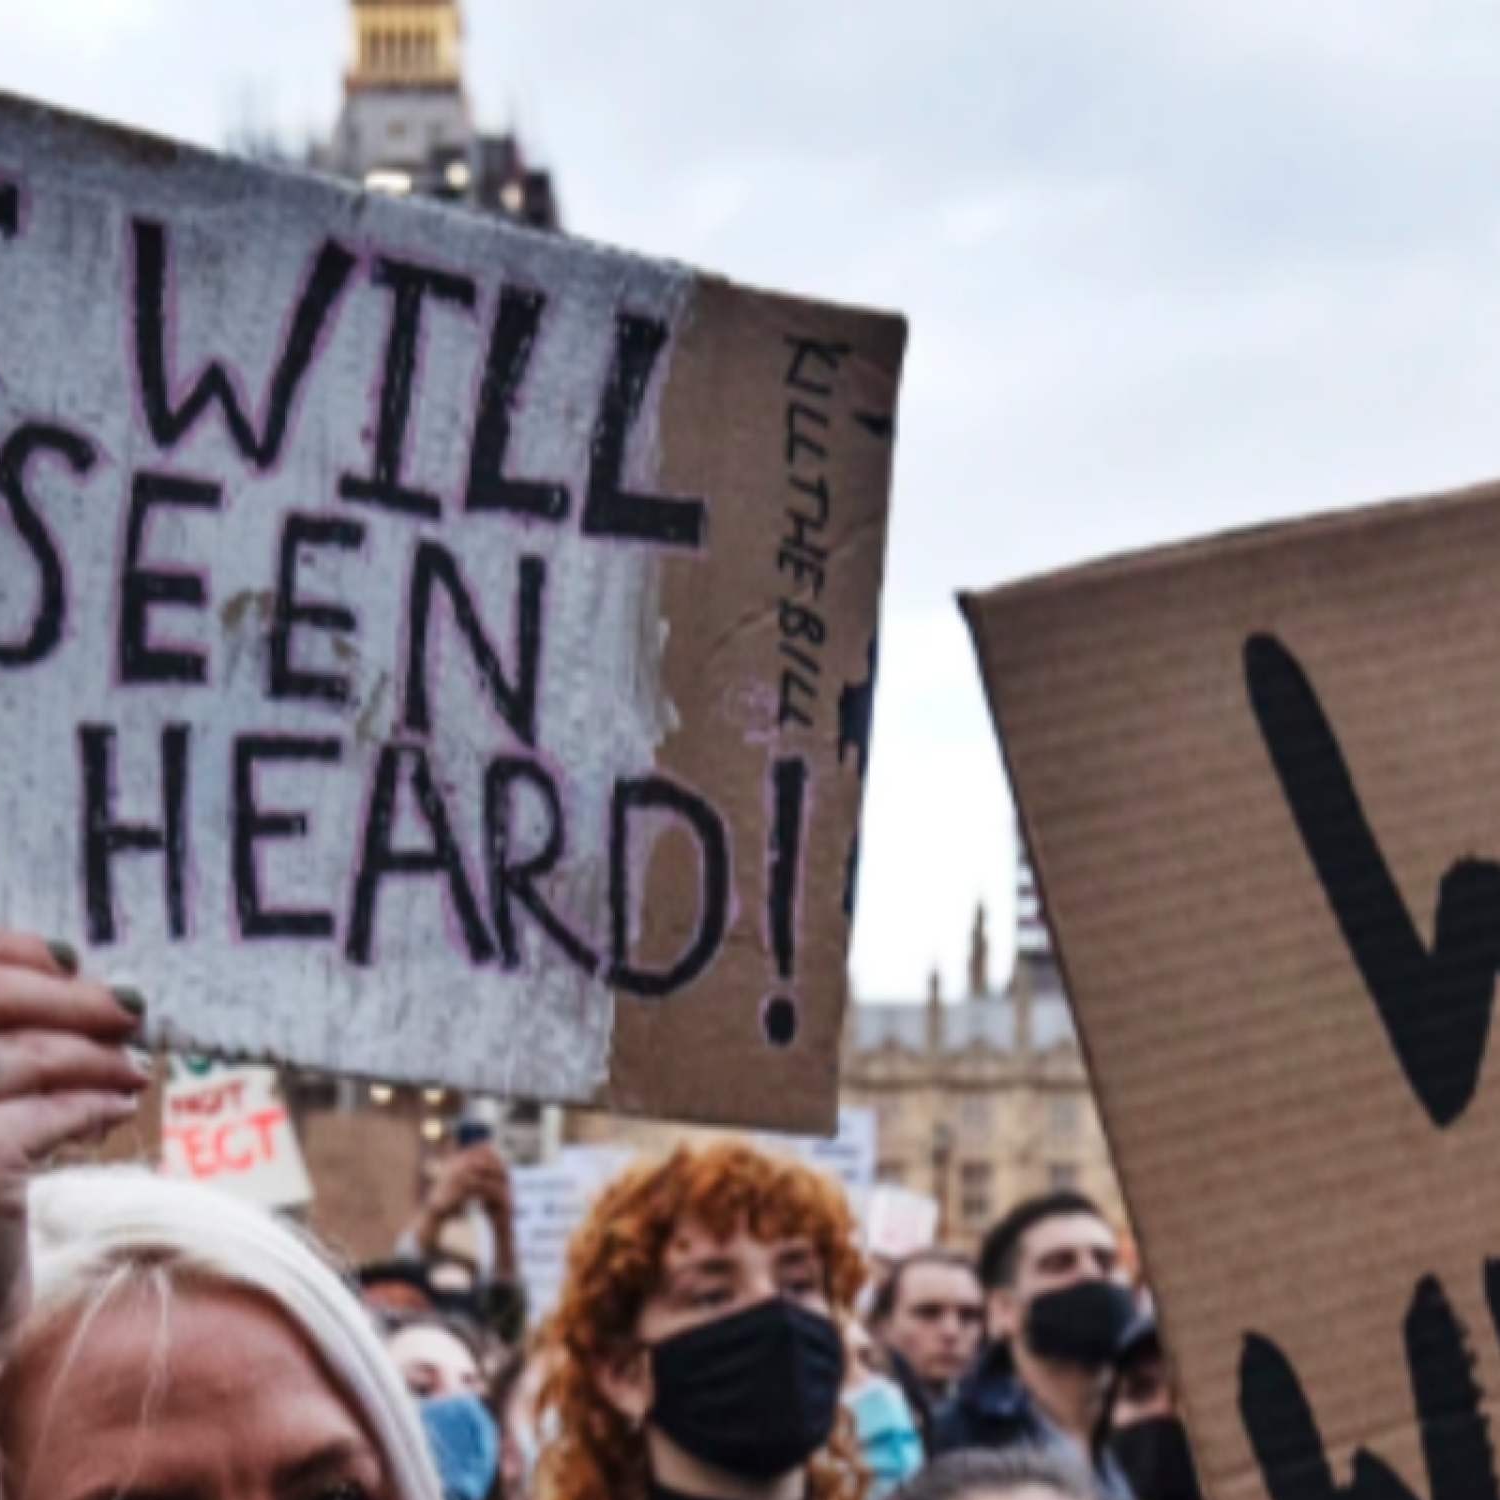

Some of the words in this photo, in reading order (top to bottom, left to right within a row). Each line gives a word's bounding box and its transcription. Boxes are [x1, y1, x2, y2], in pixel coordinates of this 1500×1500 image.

[130, 214, 710, 549] WILL
[784, 333, 850, 464] KILL
[777, 475, 830, 600] THE
[777, 596, 826, 730] BILL
[79, 725, 808, 1048] HEARD!
